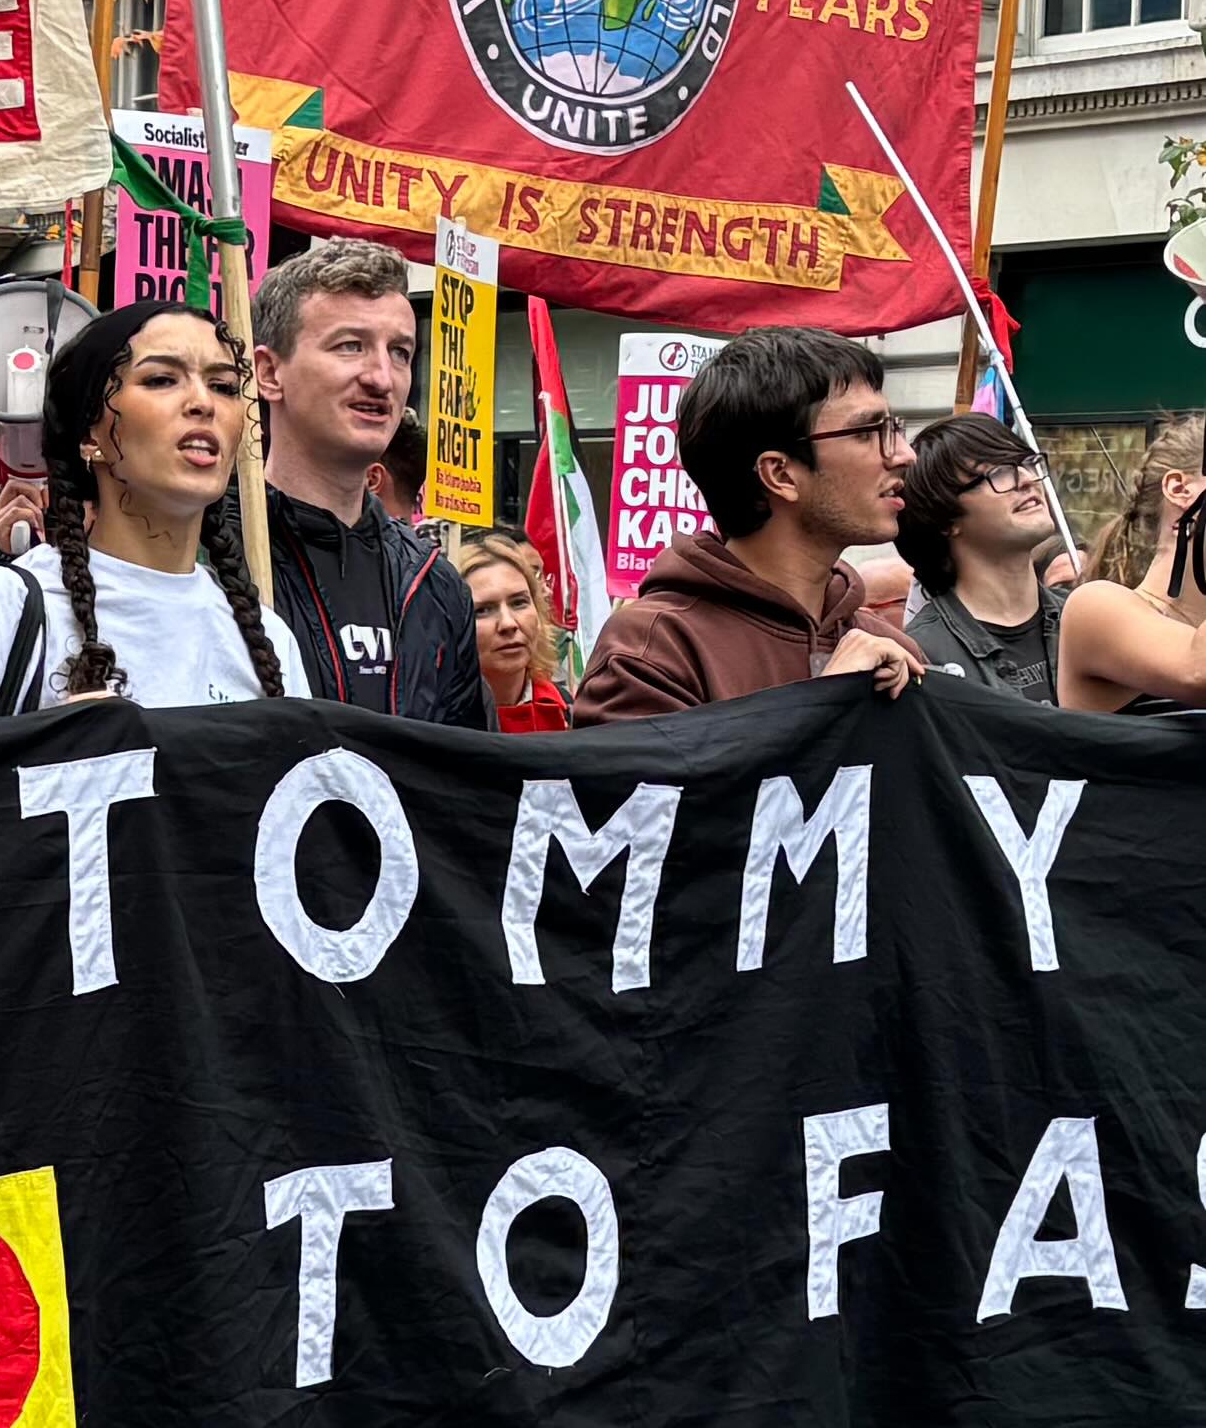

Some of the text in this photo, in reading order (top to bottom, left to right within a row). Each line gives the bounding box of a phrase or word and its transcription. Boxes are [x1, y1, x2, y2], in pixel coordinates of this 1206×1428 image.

[144, 122, 206, 149] Socialist
[521, 84, 648, 144] UNITE
[306, 139, 469, 220] UNITY
[498, 180, 543, 233] IS
[577, 198, 820, 270] STRENGTH
[18, 748, 1089, 996] TOMMY
[264, 1145, 622, 1389] TO
